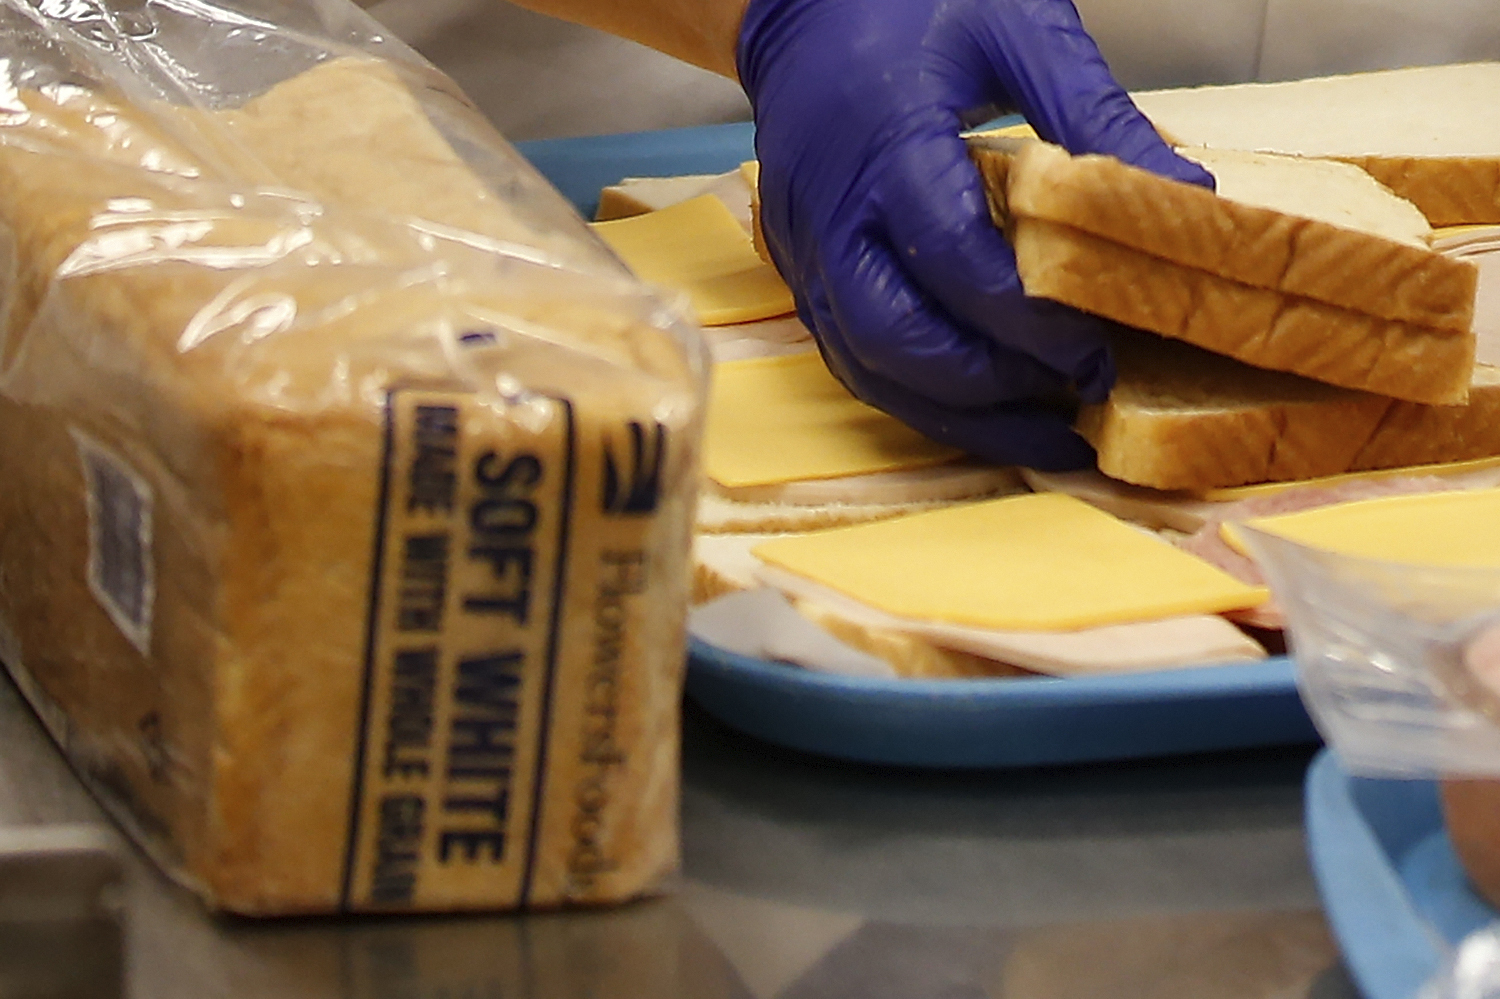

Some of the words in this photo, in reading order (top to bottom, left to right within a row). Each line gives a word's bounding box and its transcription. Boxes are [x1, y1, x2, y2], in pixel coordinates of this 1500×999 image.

[407, 404, 458, 518] MADE
[397, 535, 449, 634] WITH
[464, 451, 544, 627] SOFT
[385, 649, 438, 781] WHOLE
[439, 652, 523, 863] WHITE
[371, 796, 425, 909] GRAIN
